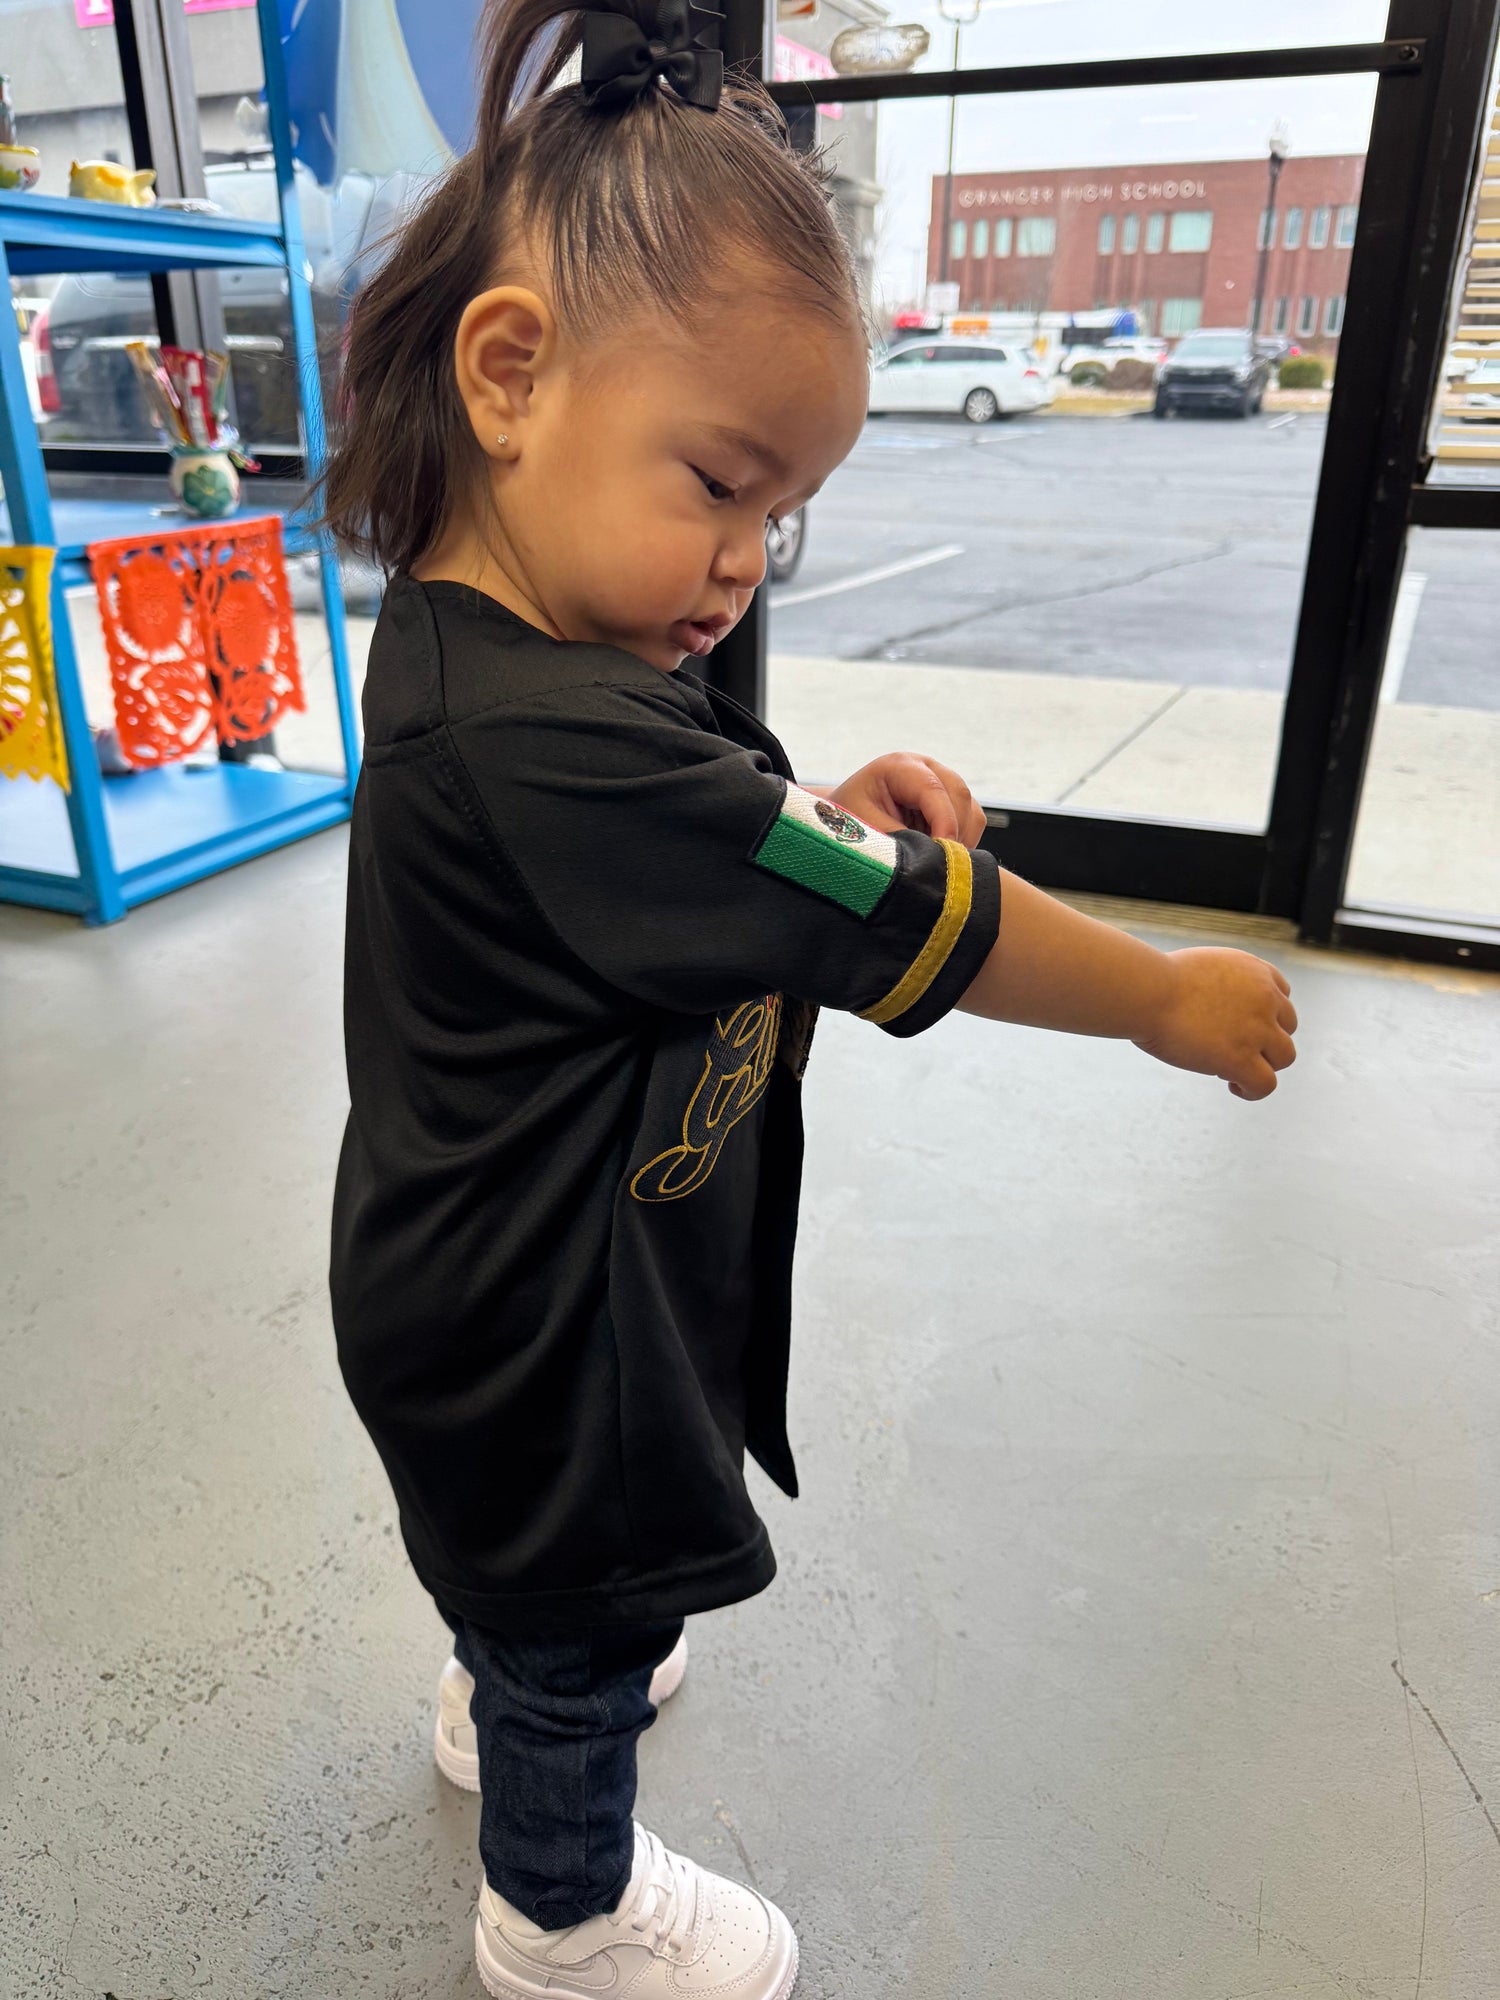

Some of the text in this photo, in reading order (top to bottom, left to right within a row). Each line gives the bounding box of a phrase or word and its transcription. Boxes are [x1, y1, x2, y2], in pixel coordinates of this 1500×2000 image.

[959, 179, 1207, 208] GRANGER HIGH SCHOOL
